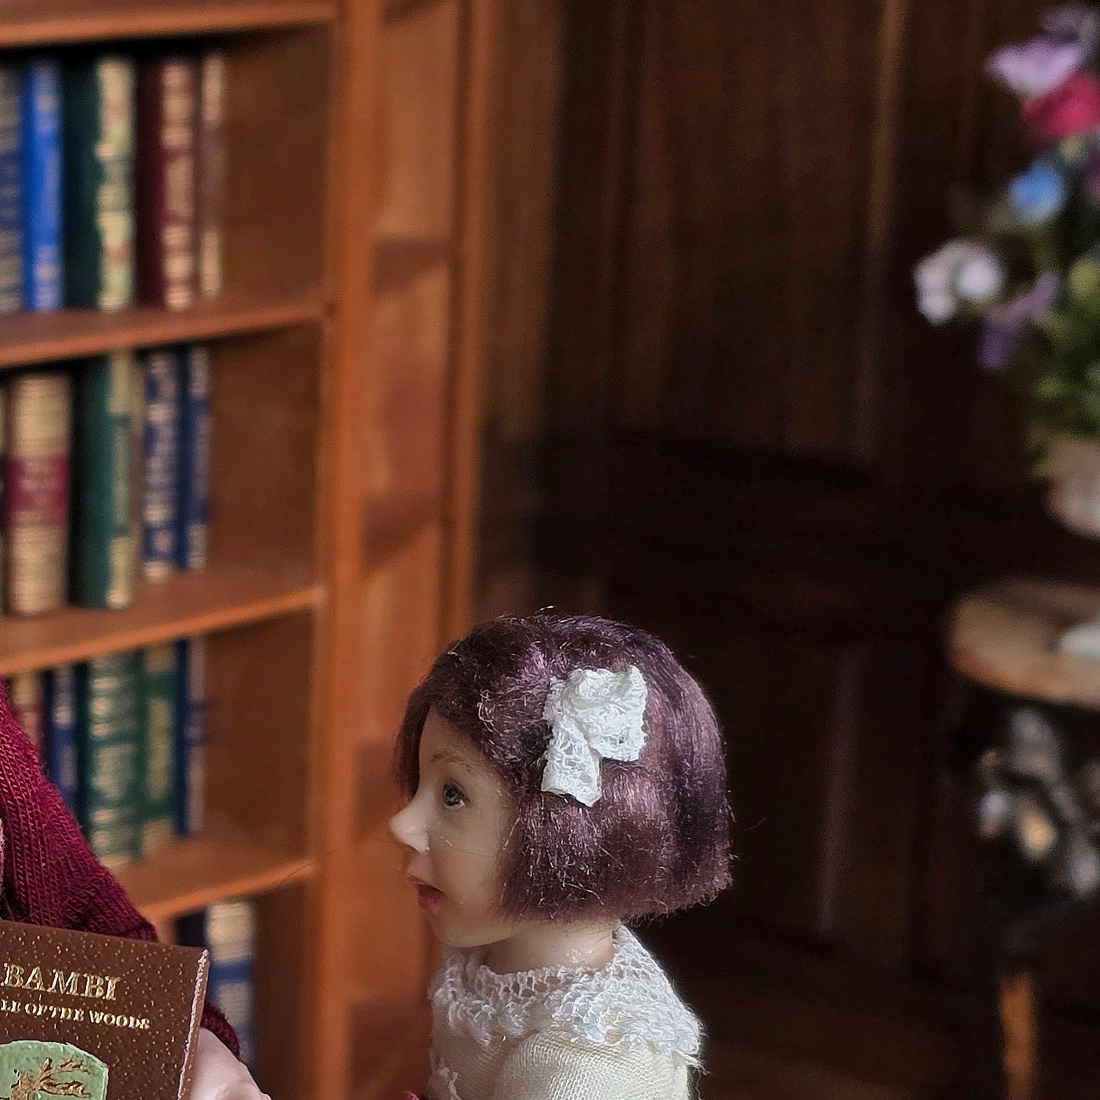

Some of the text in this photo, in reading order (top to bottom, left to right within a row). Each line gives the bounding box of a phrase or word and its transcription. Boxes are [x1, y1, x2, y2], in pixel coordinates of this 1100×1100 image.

[1, 963, 122, 1001] BAMBI
[49, 1005, 85, 1022] THE
[89, 1010, 151, 1030] WOODS
